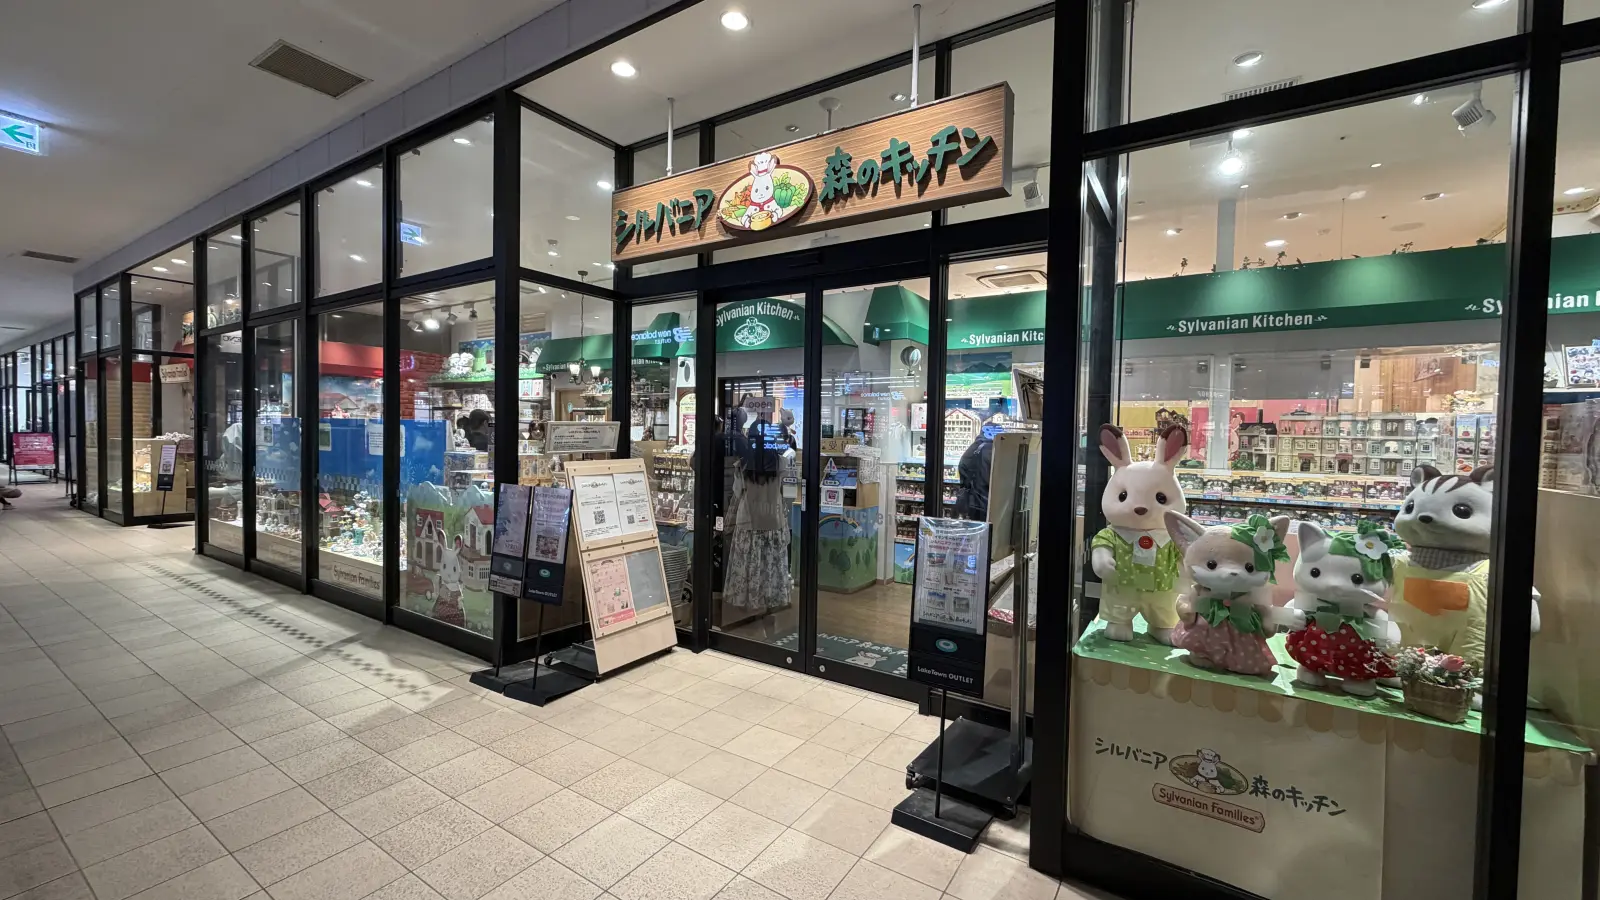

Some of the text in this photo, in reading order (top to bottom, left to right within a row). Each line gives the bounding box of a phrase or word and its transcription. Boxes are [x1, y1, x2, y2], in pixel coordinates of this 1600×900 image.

[818, 125, 993, 202] 森のキッチン
[614, 188, 716, 244] シルバニア
[757, 301, 794, 321] Kitchen
[1178, 312, 1314, 334] Sylvanian Kitchen
[969, 330, 1044, 346] Sylvanian Kitc
[748, 400, 773, 411] open
[917, 665, 974, 684] LakeTown OUTLET
[1094, 737, 1168, 770] シルバニア
[1158, 787, 1256, 825] Sylvanian Families
[1248, 775, 1348, 817] 森のキッチン
